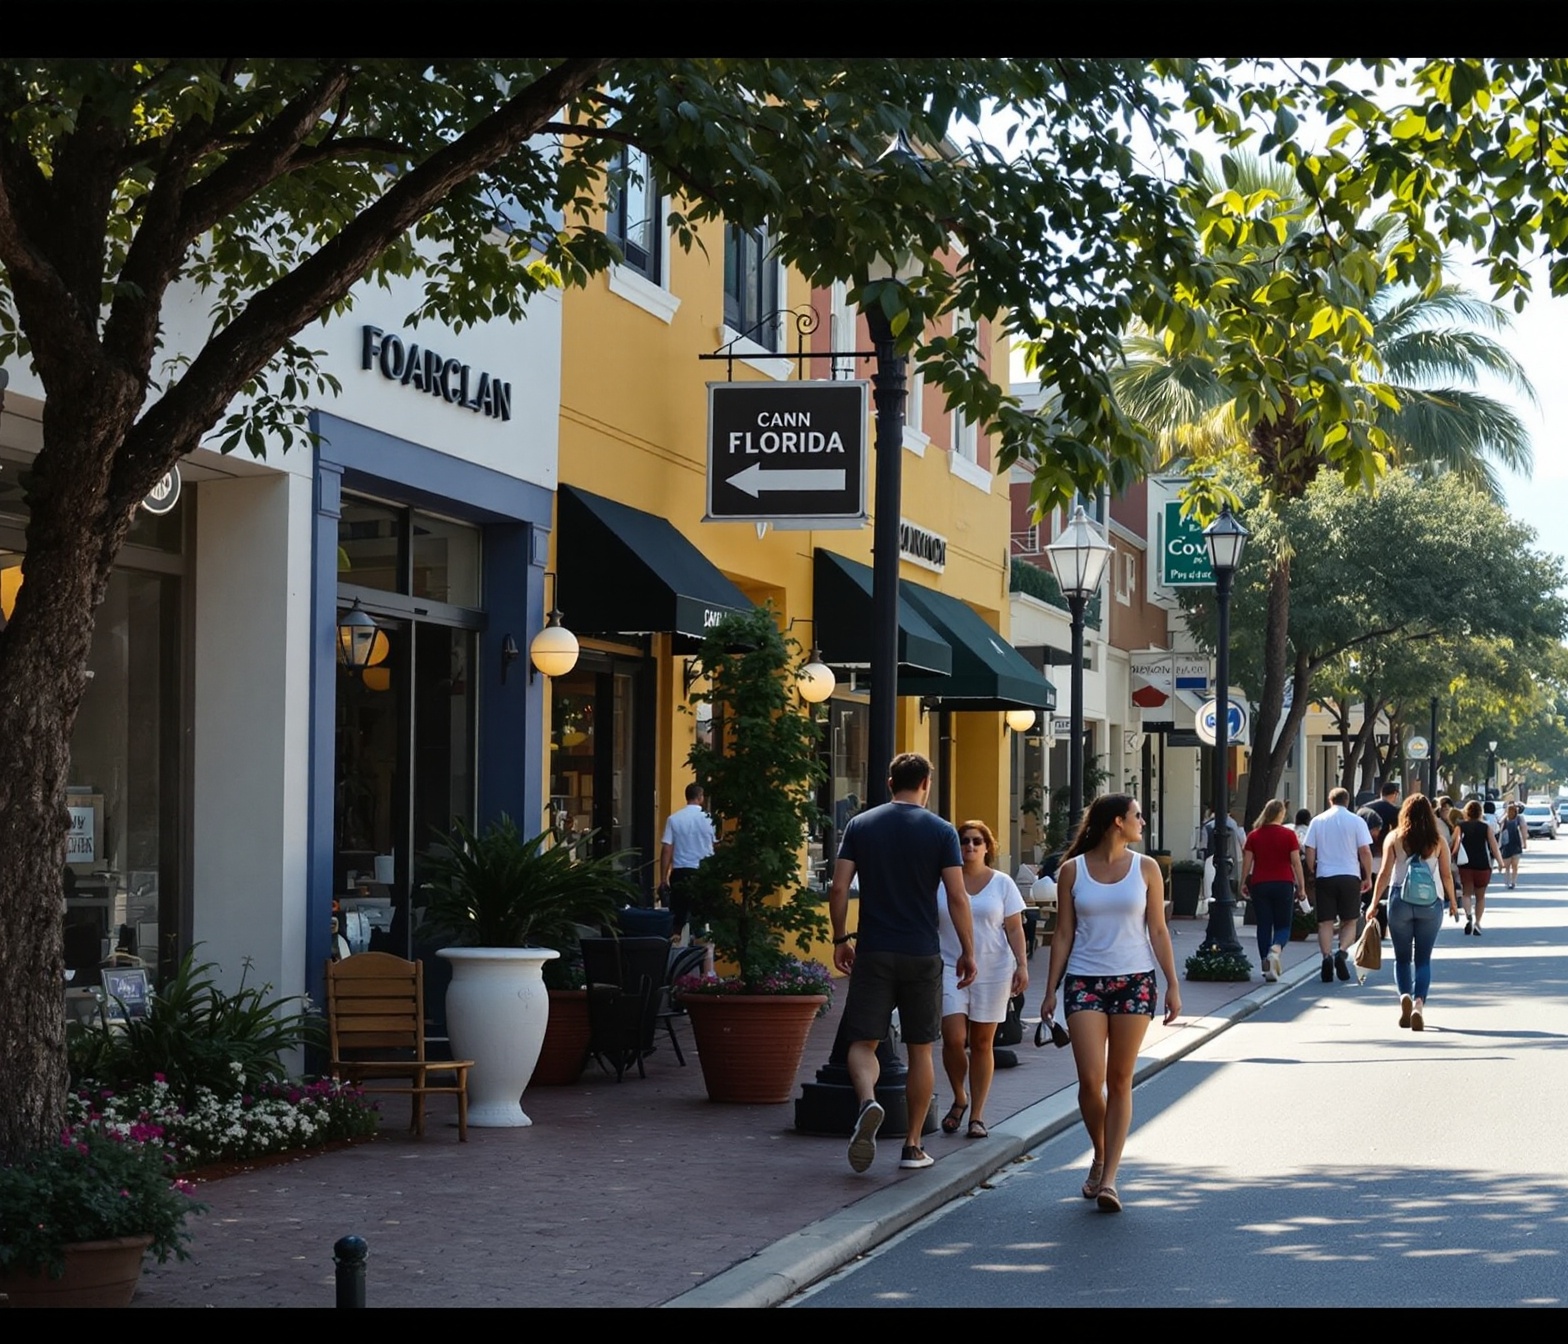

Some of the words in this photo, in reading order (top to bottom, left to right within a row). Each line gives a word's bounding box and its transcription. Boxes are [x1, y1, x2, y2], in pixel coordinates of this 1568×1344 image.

[362, 325, 511, 421] FOARCLAN
[757, 411, 811, 427] CANN
[729, 431, 845, 454] FLORIDA
